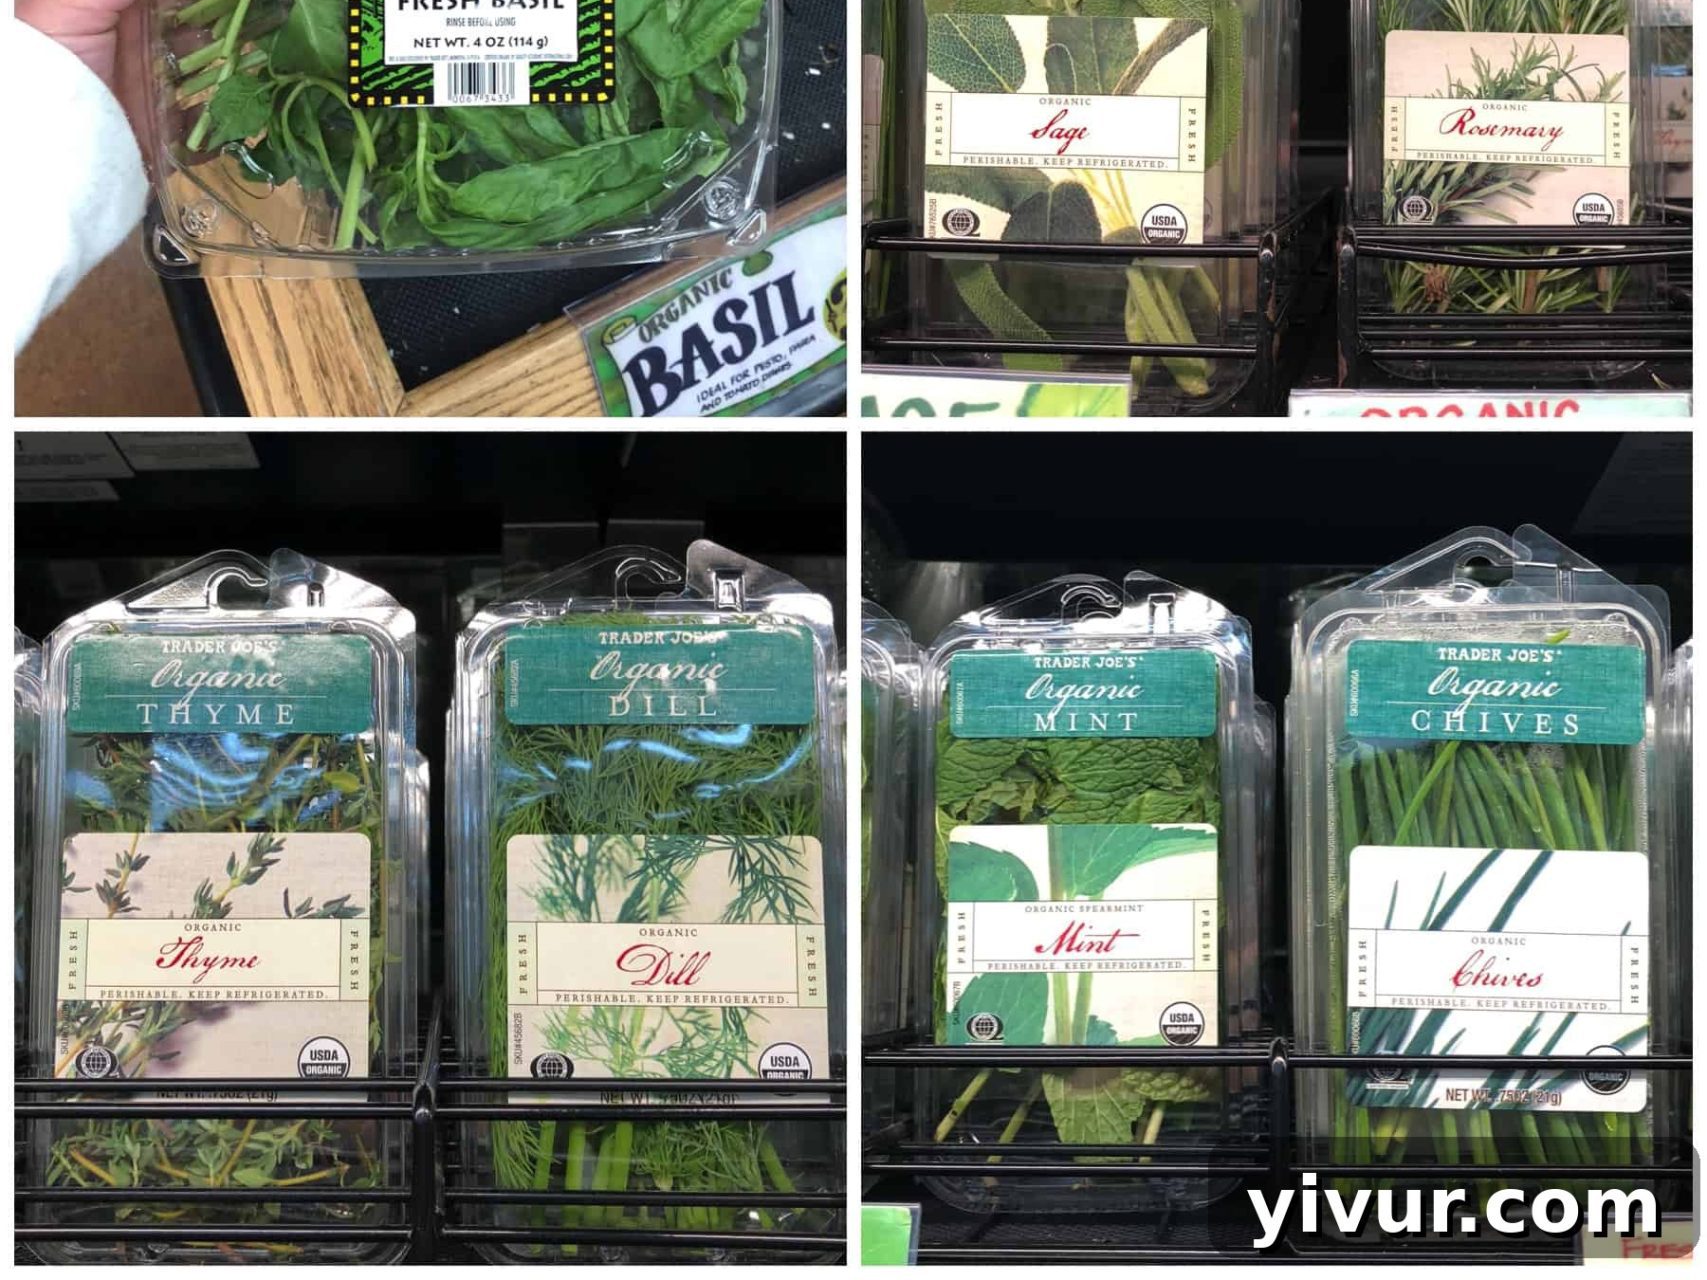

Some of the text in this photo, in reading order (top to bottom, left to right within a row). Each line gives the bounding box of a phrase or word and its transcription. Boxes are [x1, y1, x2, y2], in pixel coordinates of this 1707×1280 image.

[446, 17, 516, 27] RINSE USING
[413, 37, 441, 48] NET
[444, 37, 470, 48] WT.
[473, 37, 481, 48] 4
[485, 36, 505, 48] OZ
[508, 35, 533, 48] (114
[1039, 97, 1092, 106] ORGANIC
[1482, 103, 1528, 112] ORGANIC
[935, 102, 943, 156] FRESH
[1028, 108, 1089, 156] Sage
[1187, 108, 1197, 162] FRESH
[1440, 106, 1564, 152] Rosemary
[1613, 111, 1621, 159] FRESH
[963, 155, 1168, 169] PERISHABLE. KEEP REFRIGERATED.
[1417, 152, 1513, 162] PERISHABLE. KEEP
[1582, 202, 1605, 212] USDA
[1151, 215, 1178, 226] USDA
[1578, 214, 1610, 223] ORGANIC
[1147, 229, 1181, 238] ORGANIC
[637, 267, 734, 343] ORGANIC
[621, 270, 816, 417] BASIL
[697, 368, 750, 404] IDEAL FOR
[700, 396, 722, 413] AND
[599, 632, 665, 644] TRADER
[162, 640, 224, 653] TRADER
[1438, 647, 1554, 662] TRADER JOE'S
[1034, 656, 1136, 669] TRADER JOE'S
[589, 650, 728, 701] Organic
[151, 659, 288, 709] Organic
[1427, 666, 1563, 718] Organic
[1025, 673, 1145, 720] Organic
[608, 695, 717, 716] DILL
[136, 703, 294, 725] THYME
[1411, 709, 1579, 735] CHIVES
[1034, 713, 1138, 732] MINT
[1025, 904, 1145, 913] ORGANIC SPEARMINT
[184, 923, 242, 932] ORGANIC
[639, 928, 698, 937] ORGANIC
[957, 912, 966, 964] FRESH
[1034, 920, 1140, 956] Mint
[1202, 910, 1210, 962] FRESH
[1471, 936, 1526, 946] ORGANIC
[68, 930, 78, 990] FRESH
[156, 935, 262, 984] Thyme
[350, 931, 359, 990] FRESH
[519, 934, 528, 995] FRESH
[616, 943, 711, 986] Dill
[806, 936, 817, 997] FRESH
[988, 961, 1186, 971] PERISHABLE. KEEP REFRIGERATED.
[1358, 941, 1367, 998] FRESH
[1450, 949, 1544, 990] Chives
[1630, 947, 1639, 1004] FRESH
[100, 990, 329, 1000] PERISHABLE. KEEP REFRIGERATED.
[555, 994, 789, 1005] PERISHABLE. KEEP REFRIGERATED.
[1391, 998, 1611, 1011] PERISHABLE. KEEP REFRIGERATED.
[1169, 1013, 1194, 1023] USDA
[1166, 1025, 1198, 1034] ORGANIC
[309, 1049, 339, 1062] USDA
[770, 1055, 800, 1068] USDA
[305, 1065, 343, 1076] ORGANIC
[1588, 1073, 1624, 1081] ORGANIC
[1446, 1087, 1469, 1102] NET
